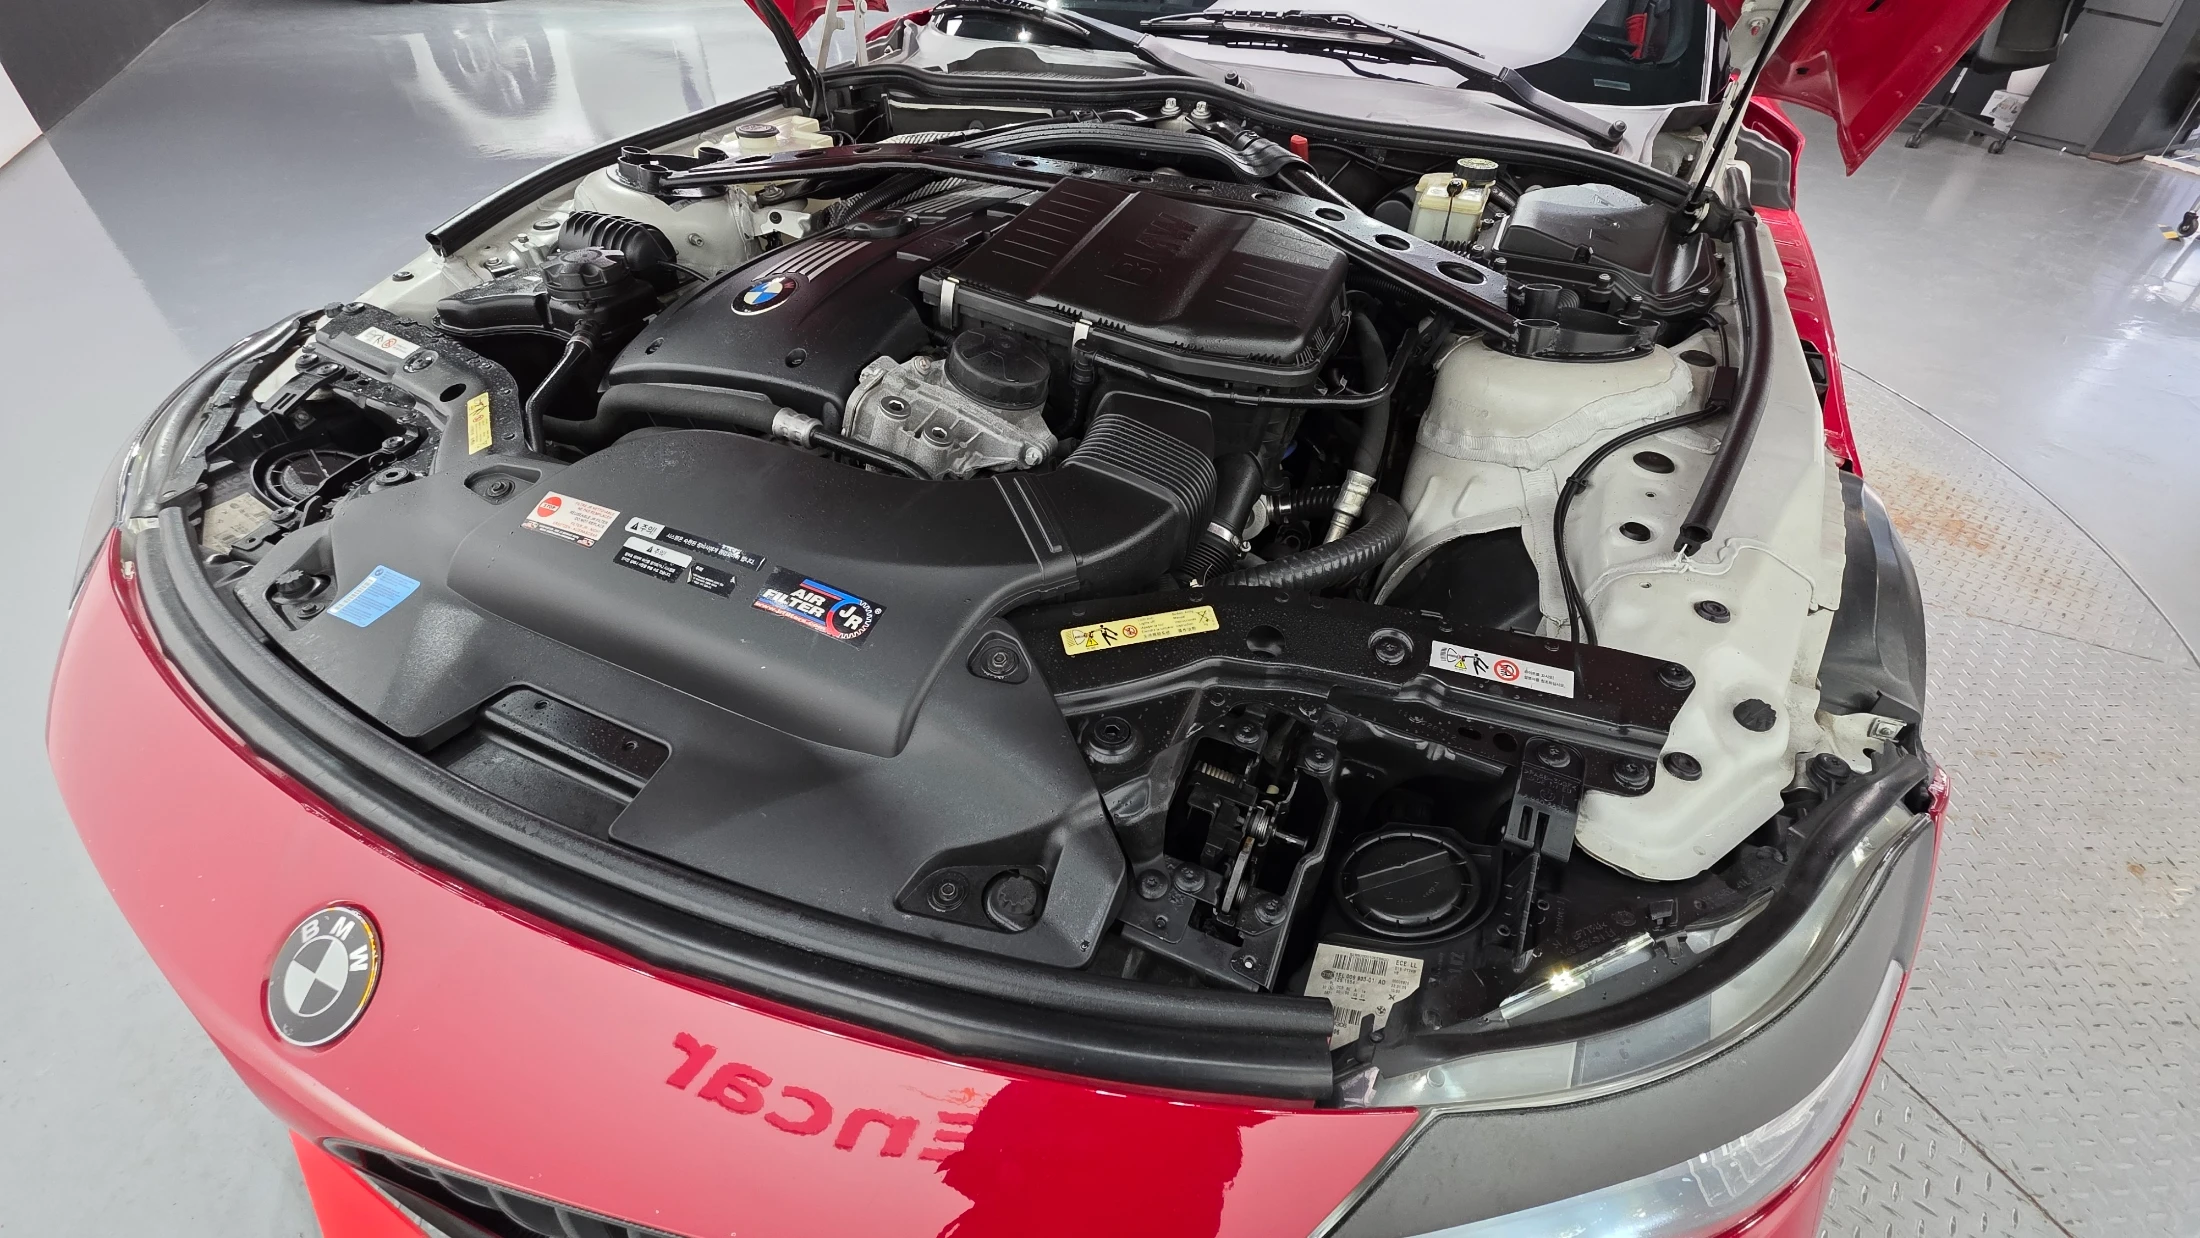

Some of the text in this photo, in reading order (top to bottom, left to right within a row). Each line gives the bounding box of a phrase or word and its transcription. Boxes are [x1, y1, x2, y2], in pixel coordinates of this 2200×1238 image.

[640, 523, 658, 536] 주의!
[762, 588, 826, 618] FILTER
[790, 588, 827, 607] AIR
[839, 606, 863, 630] JR
[301, 916, 369, 972] BMW
[1395, 959, 1408, 967] ECE
